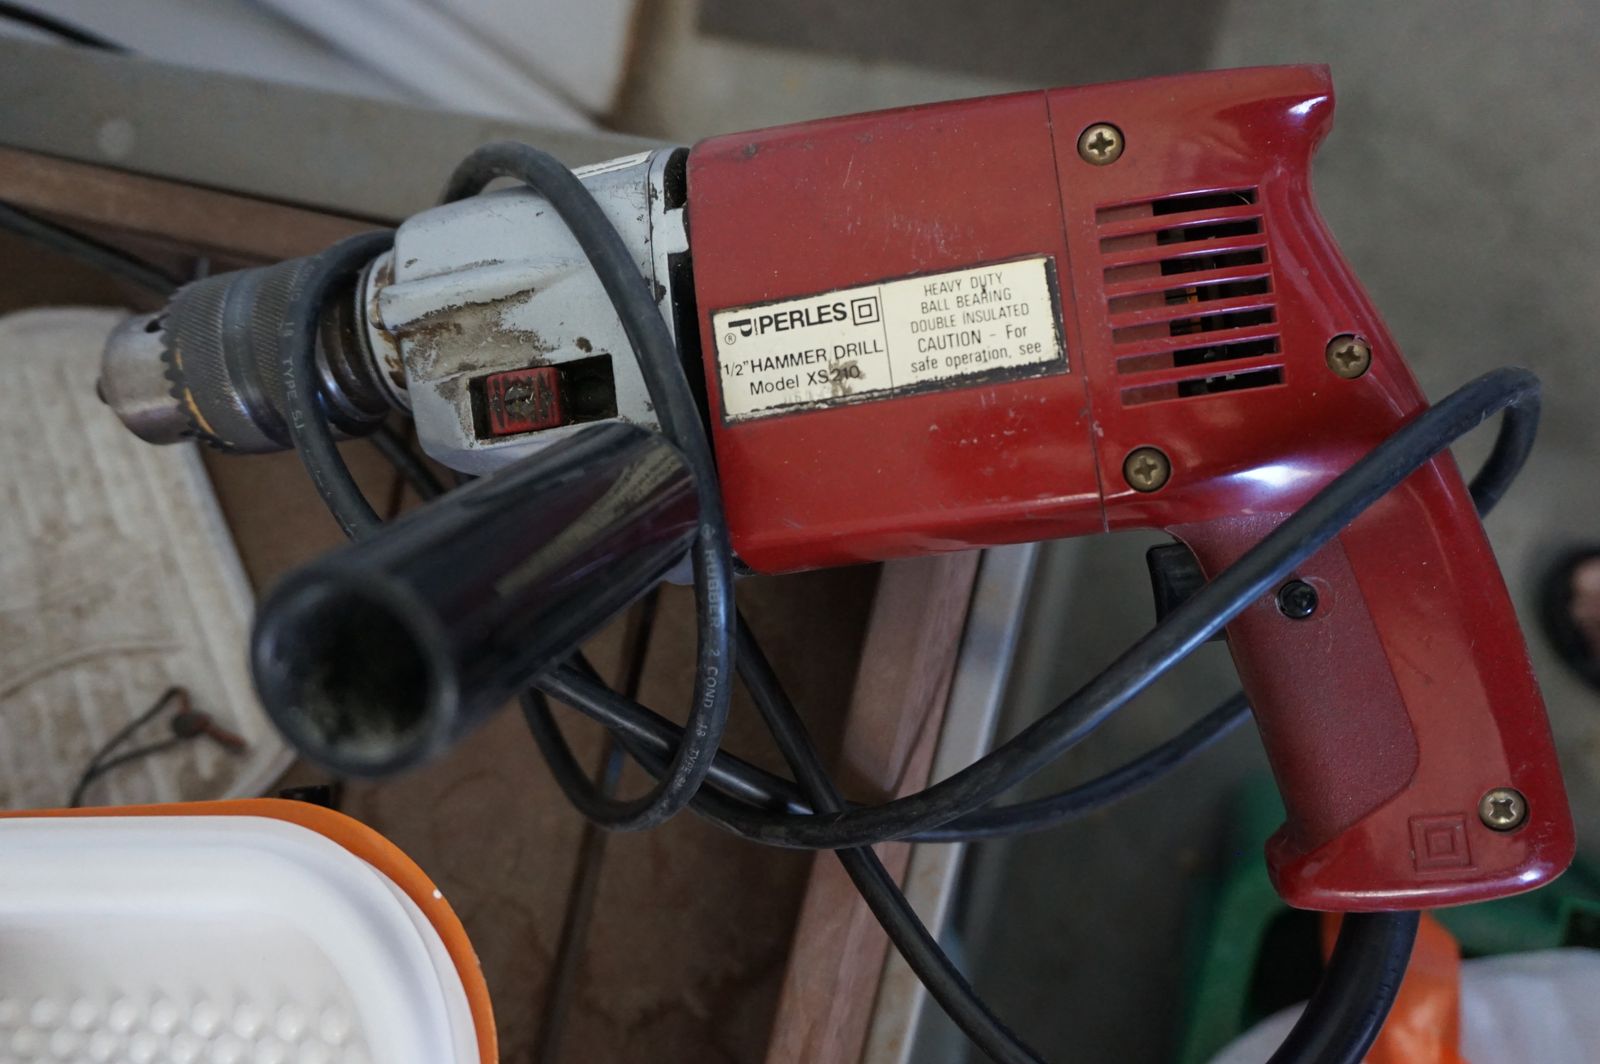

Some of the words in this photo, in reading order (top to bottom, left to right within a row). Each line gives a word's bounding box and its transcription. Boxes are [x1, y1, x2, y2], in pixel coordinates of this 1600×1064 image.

[923, 279, 963, 297] HEAVY
[970, 272, 1003, 289] DUTY
[920, 298, 950, 314] BALL
[956, 287, 1012, 309] BEARING
[758, 302, 848, 335] PERLES
[910, 312, 957, 334] DOUBLE
[962, 303, 1030, 325] INSULATED
[833, 339, 884, 360] DRILL
[917, 329, 982, 353] CAUTION
[1005, 324, 1027, 339] For
[910, 355, 939, 373] safe
[1019, 342, 1042, 356] see
[282, 356, 299, 400] TYPE
[749, 375, 800, 396] Model
[806, 365, 861, 386] XS210
[704, 549, 721, 628] RUBBER
[711, 649, 720, 657] 2
[703, 666, 718, 708] COND
[681, 749, 700, 775] TYPE
